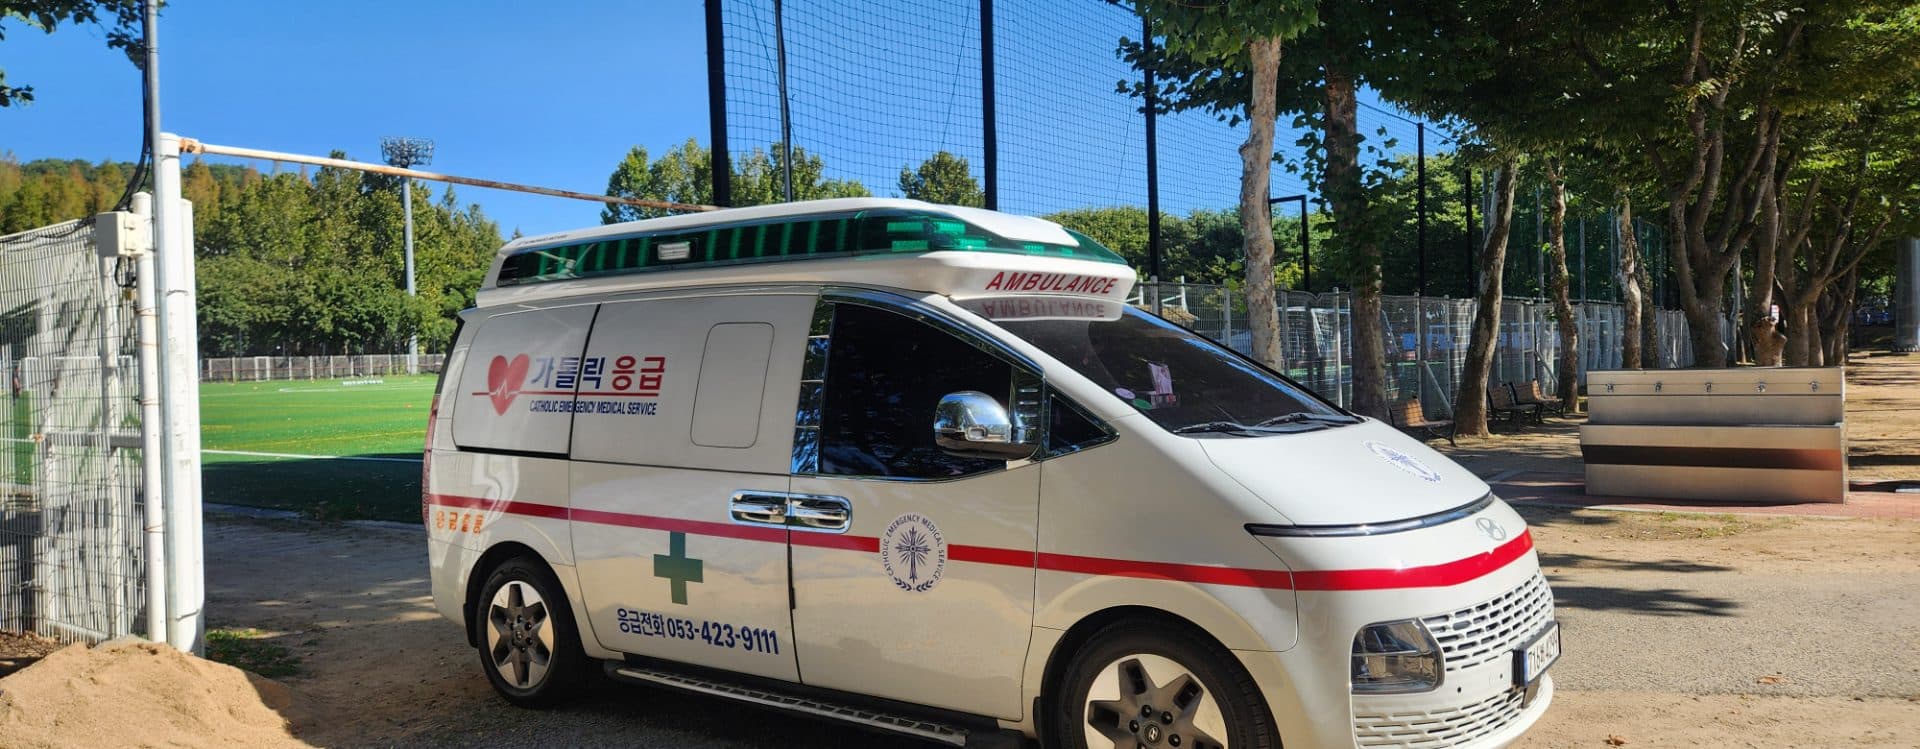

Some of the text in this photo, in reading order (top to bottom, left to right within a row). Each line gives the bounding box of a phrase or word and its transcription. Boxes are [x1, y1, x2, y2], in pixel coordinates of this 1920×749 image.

[985, 271, 1119, 294] AMBULANCE
[531, 355, 666, 391] 가톨릭 응급
[530, 400, 559, 413] CATHOLIC
[597, 401, 625, 415] MEDICAL
[627, 402, 658, 416] SERVICE
[882, 514, 945, 581] CATHOLIC EMERGENCY MEDICAL SERVICE
[617, 608, 779, 655] 응급전화 053-423-9111
